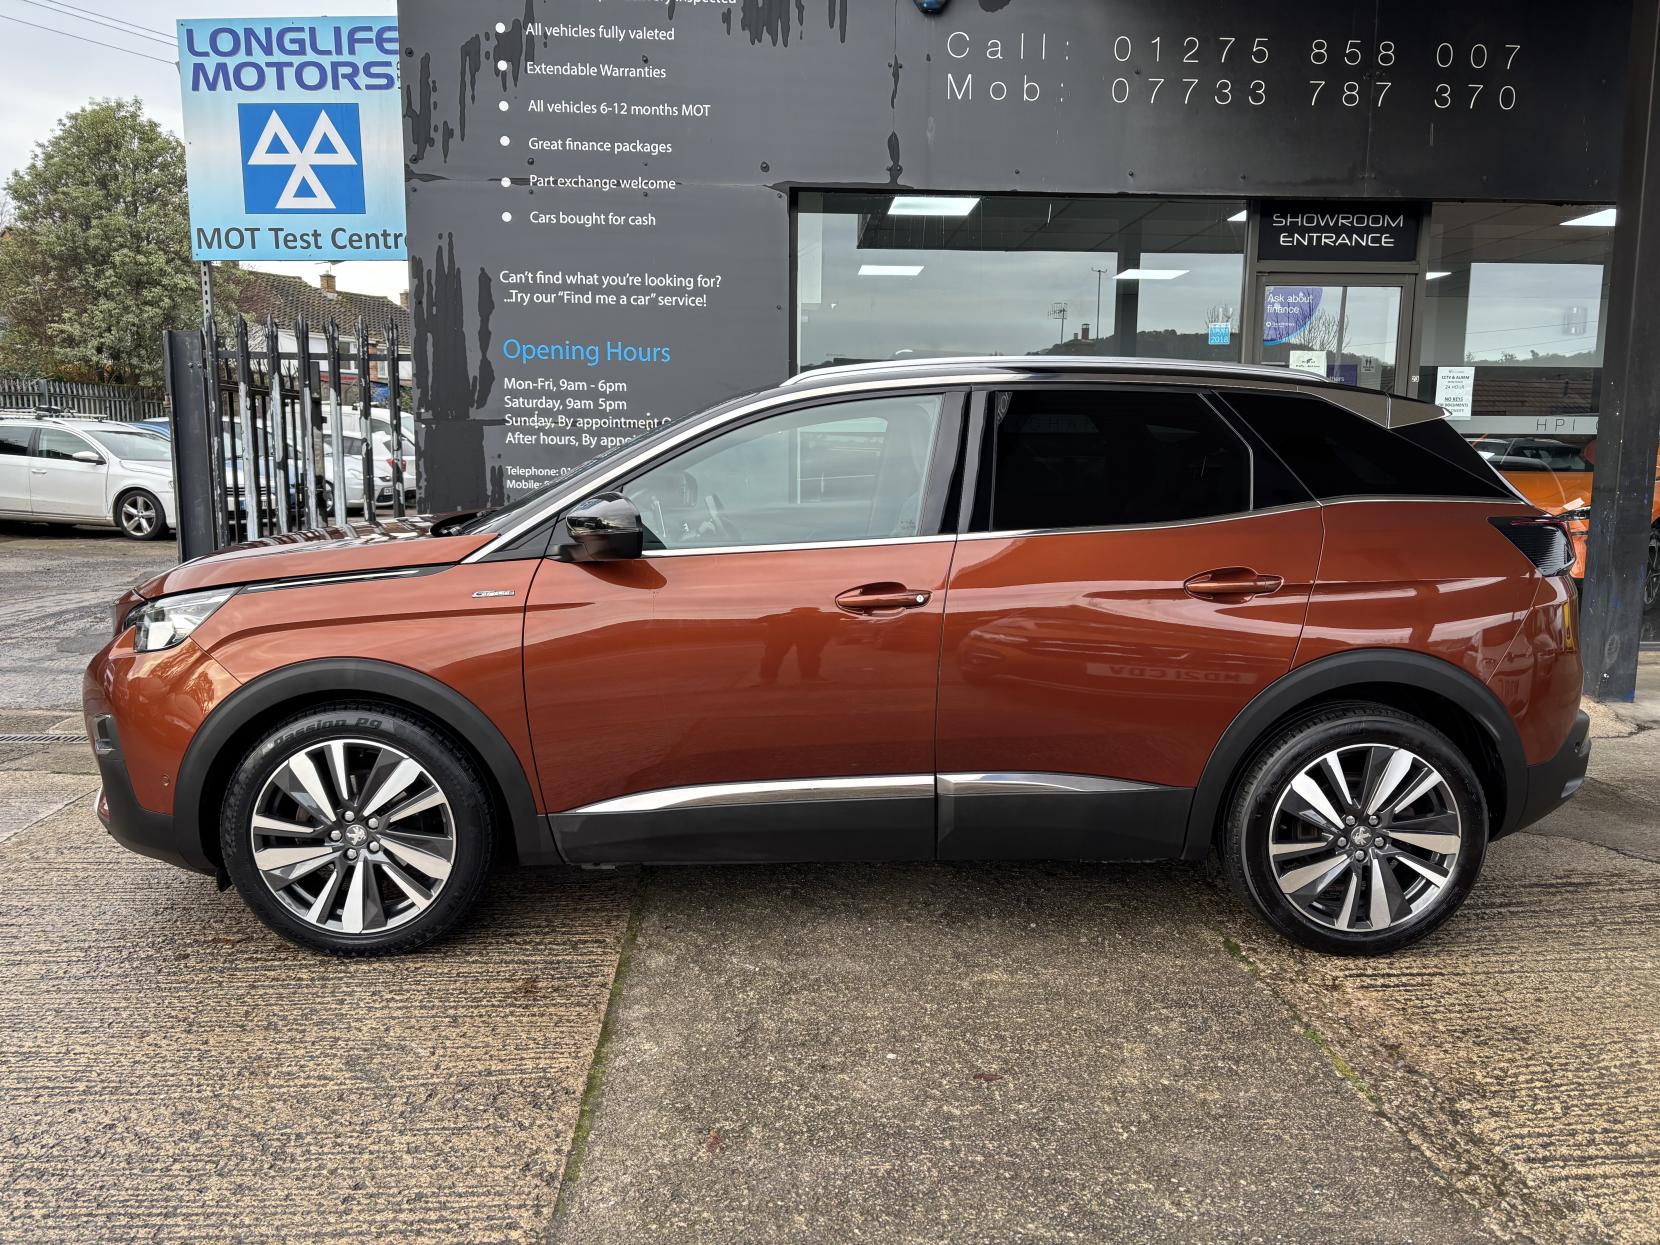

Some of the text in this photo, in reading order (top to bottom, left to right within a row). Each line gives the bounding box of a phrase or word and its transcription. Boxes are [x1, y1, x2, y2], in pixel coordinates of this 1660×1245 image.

[526, 23, 676, 42] All vehicles fully valeted
[186, 26, 399, 58] LONGLIFE
[946, 31, 1522, 70] Call: 01275 858 007
[191, 60, 396, 92] MOTORS
[526, 62, 667, 78] Extendable Warranties
[946, 74, 1517, 111] Mob: 07733 787 370
[528, 100, 711, 117] All vehicles 6-12 months MOT
[528, 137, 672, 156] Great finance packages
[530, 174, 676, 192] Part exchange welcome
[530, 211, 656, 228] Cars bought for cash
[1272, 213, 1404, 228] SHOWROOM
[196, 227, 408, 250] MOT Test Centr
[1280, 232, 1396, 247] ENTRANCE
[500, 270, 722, 290] Can’t find what you’re looking for?
[534, 292, 558, 304] our
[596, 294, 617, 305] me
[620, 294, 628, 305] a
[658, 294, 708, 308] service!
[1268, 294, 1313, 303] Ask about
[1267, 304, 1300, 314] finance
[503, 338, 672, 366] Opening Hours
[504, 378, 558, 393] Mon-Fri,
[559, 379, 588, 392] 9am
[598, 380, 628, 395] 6pm
[504, 396, 628, 414] Saturday, 9am 5pm
[504, 413, 556, 431] Sunday,
[558, 415, 574, 430] By
[576, 416, 659, 430] appointment
[1536, 418, 1576, 432] HPI
[505, 432, 537, 445] After
[540, 432, 579, 447] hours,
[582, 434, 598, 449] By
[506, 466, 559, 478] Telephone:
